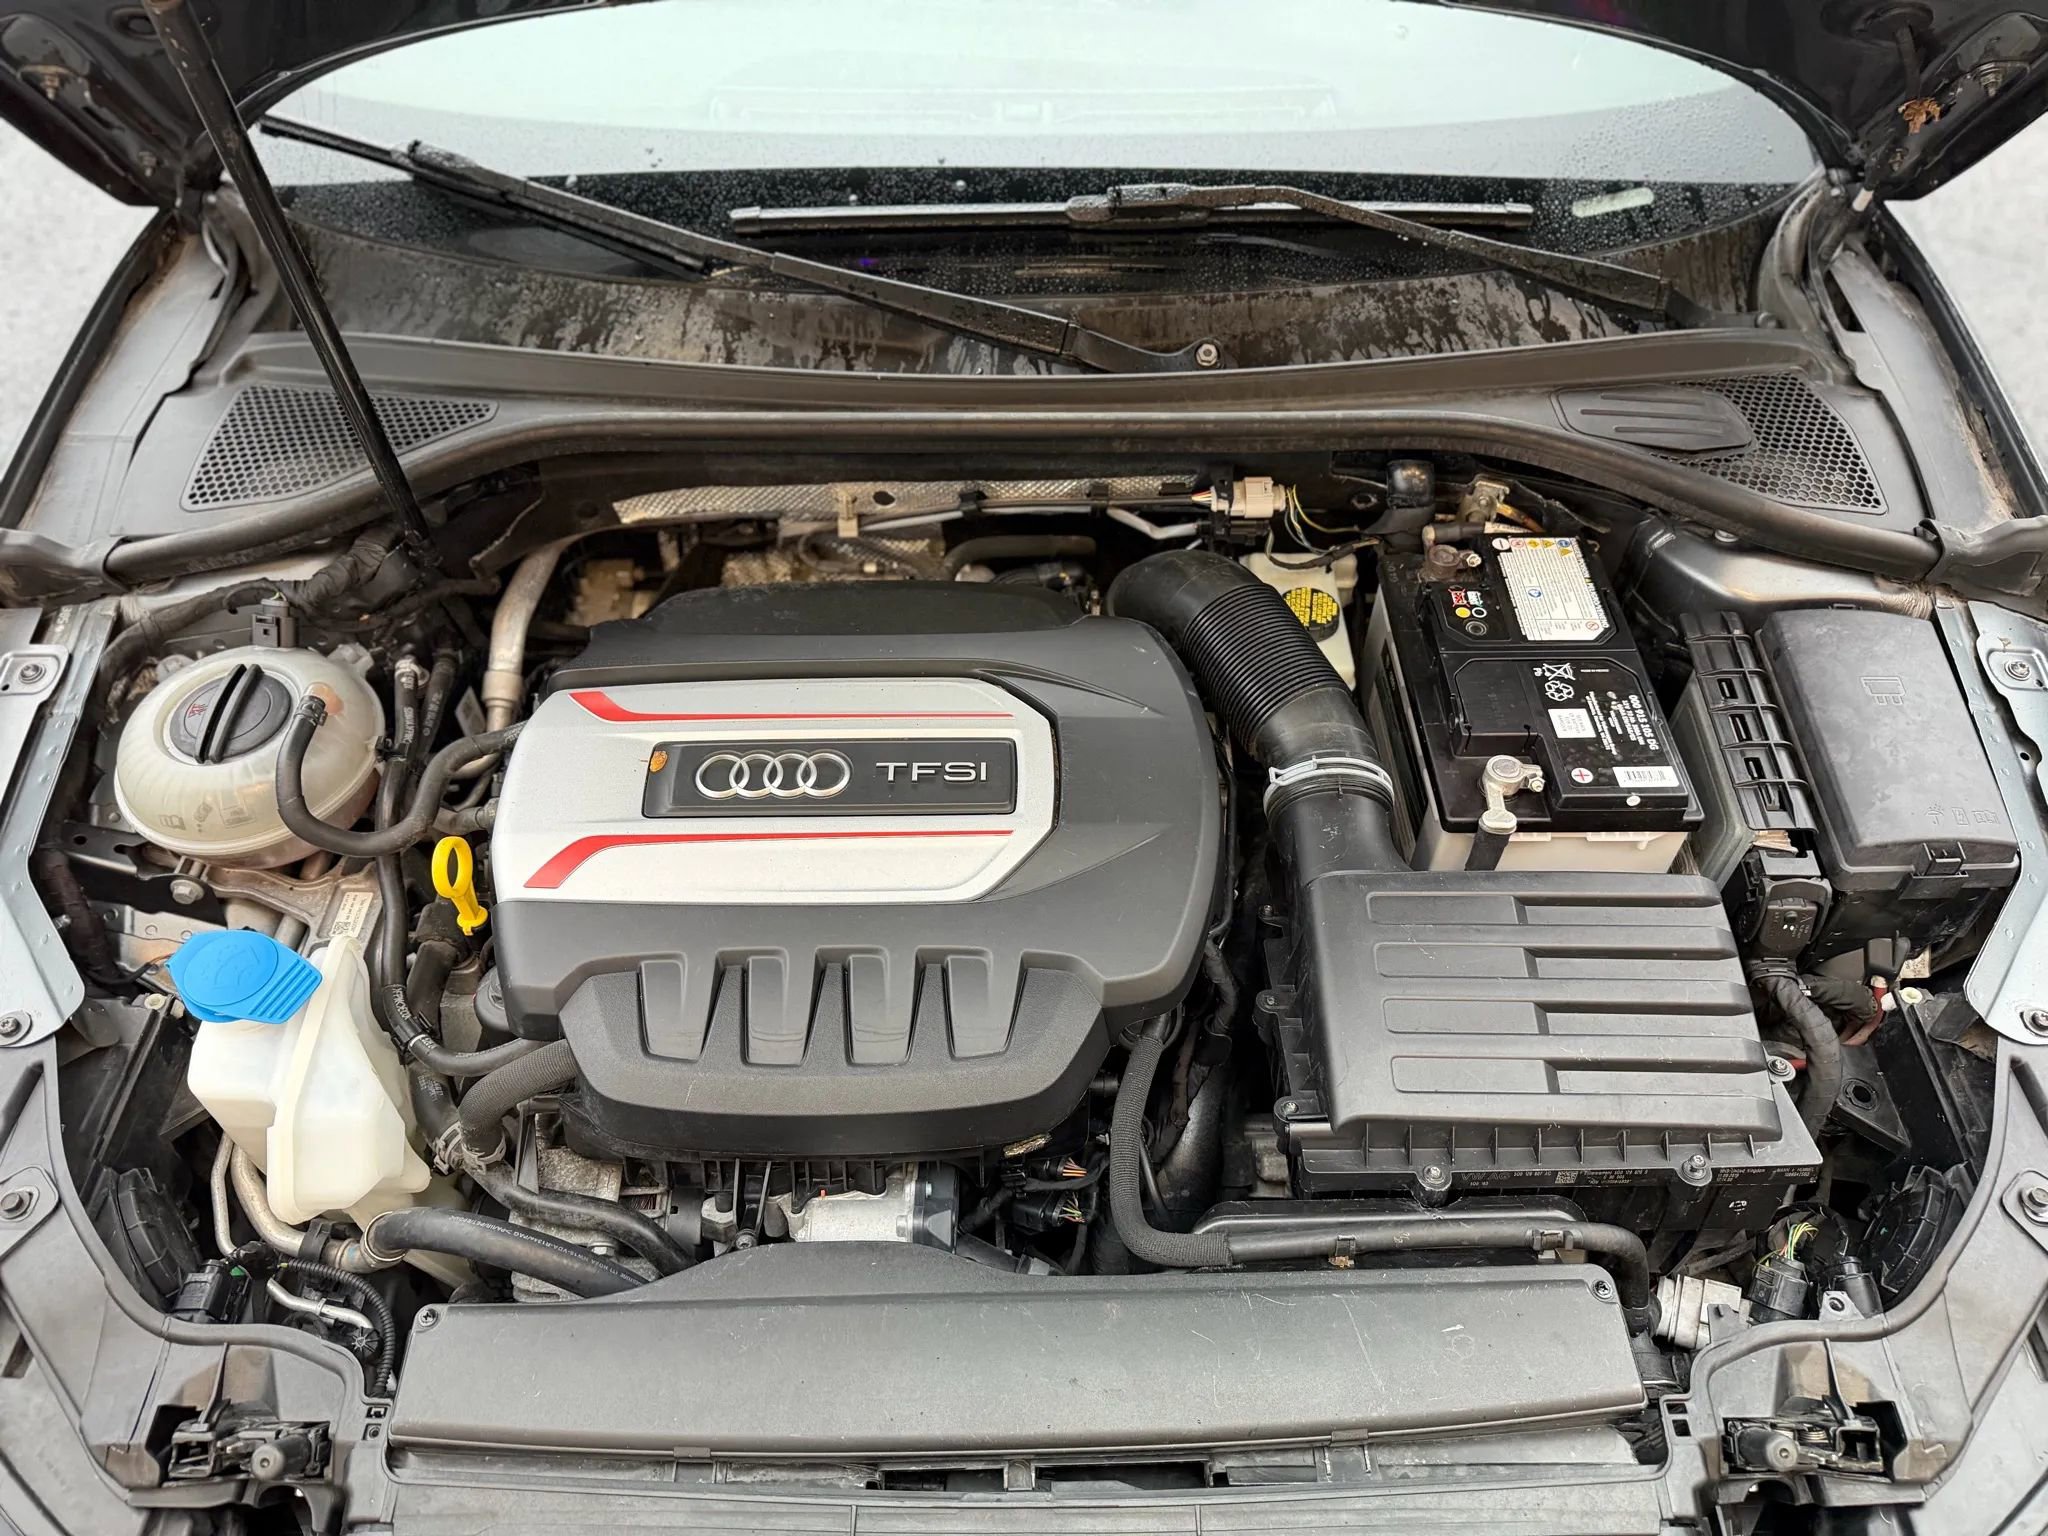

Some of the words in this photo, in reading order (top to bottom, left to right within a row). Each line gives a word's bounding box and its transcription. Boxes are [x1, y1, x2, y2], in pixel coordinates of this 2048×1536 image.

[1628, 694, 1642, 709] 000
[1635, 709, 1648, 723] 915
[1641, 724, 1654, 738] 105
[875, 762, 987, 781] TFSI
